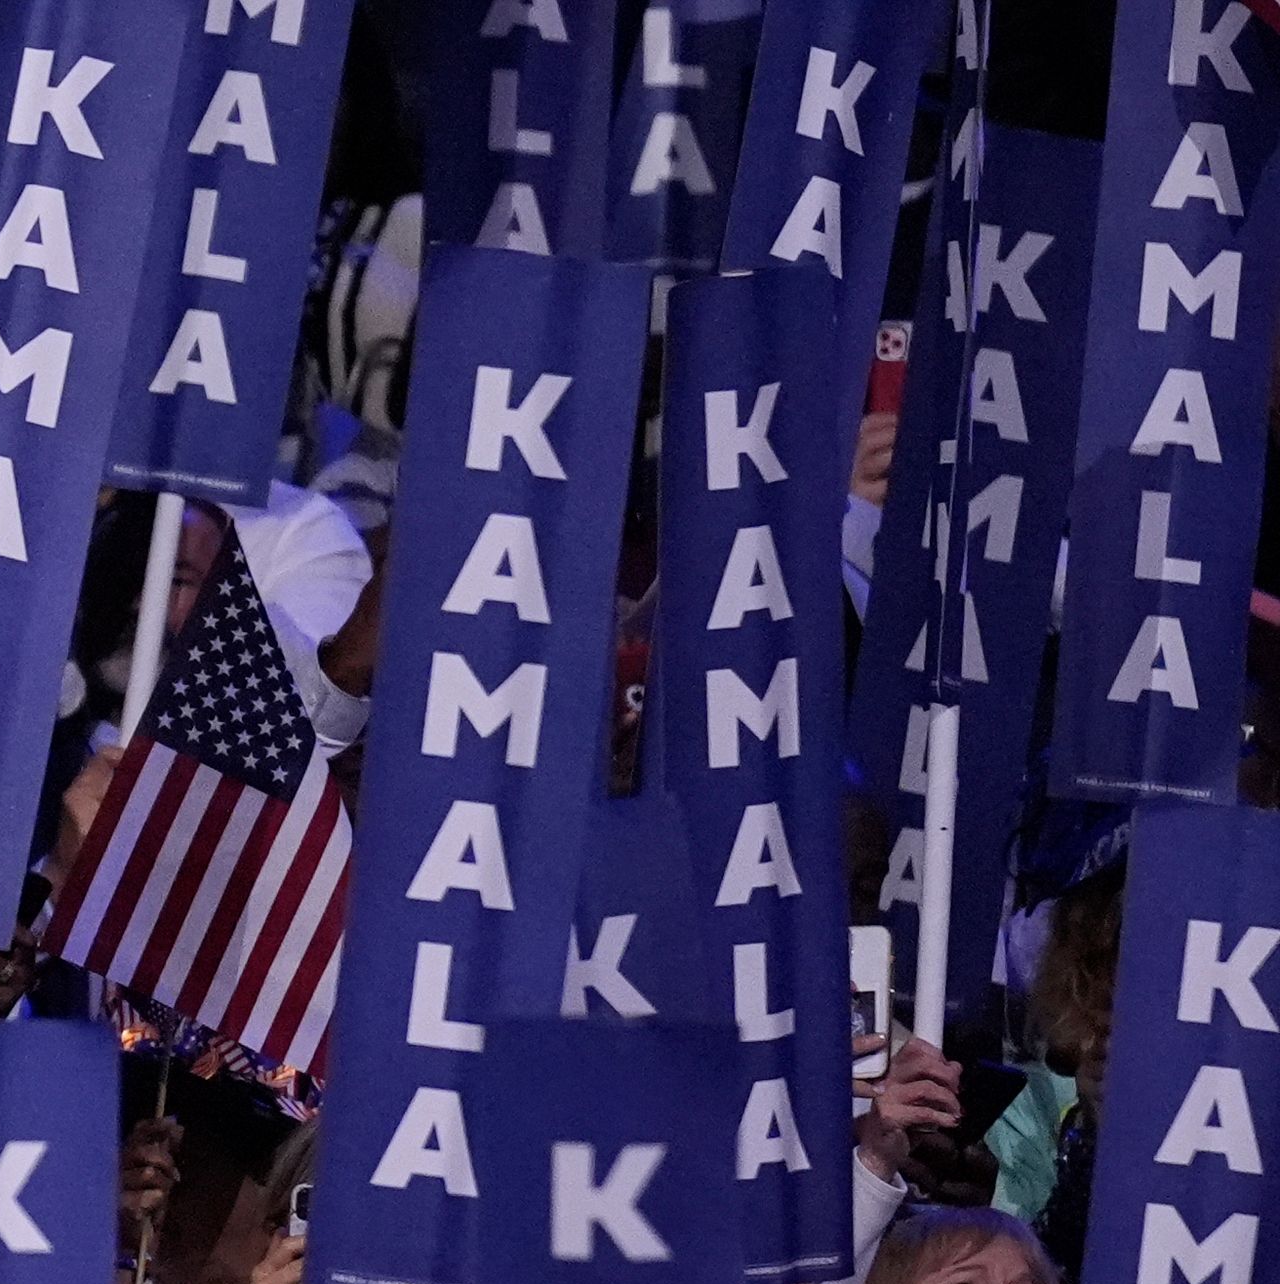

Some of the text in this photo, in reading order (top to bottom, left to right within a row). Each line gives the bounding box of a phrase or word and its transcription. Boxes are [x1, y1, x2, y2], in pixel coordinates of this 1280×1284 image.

[1107, 0, 1255, 710] KAMALA
[369, 365, 573, 1198] KAMALA
[703, 381, 812, 1181] KAMALA
